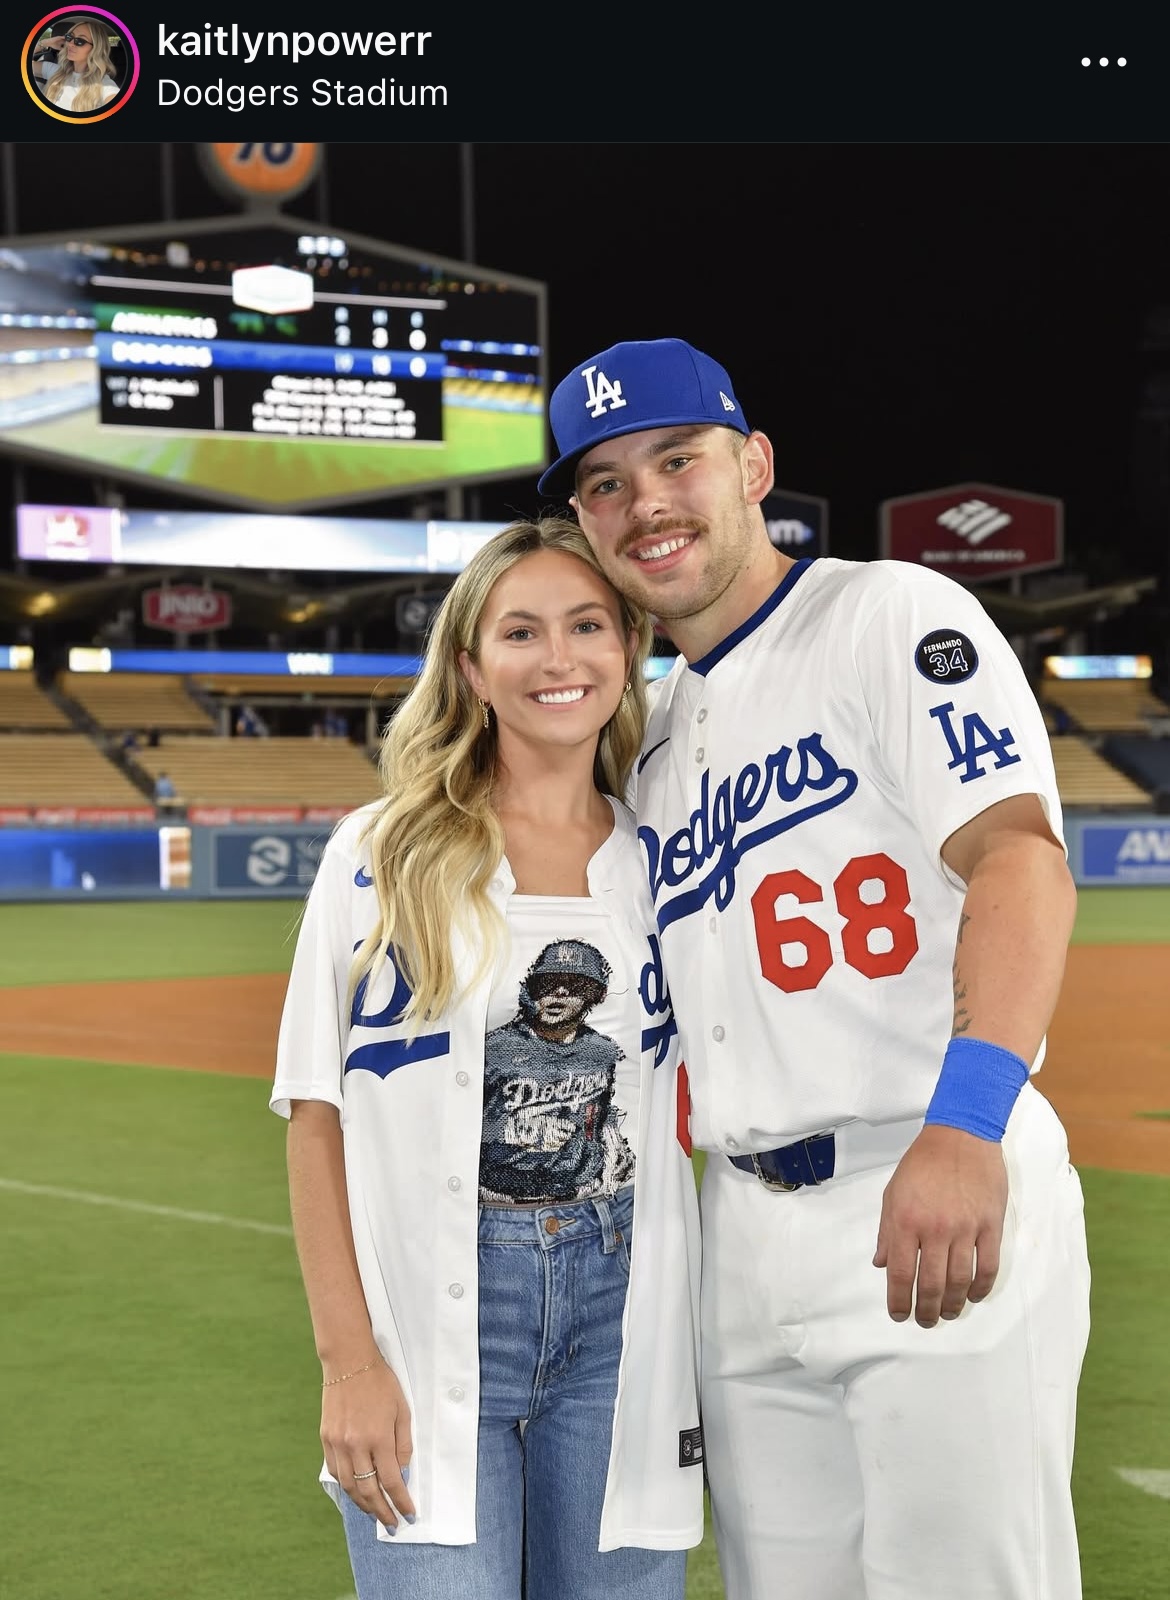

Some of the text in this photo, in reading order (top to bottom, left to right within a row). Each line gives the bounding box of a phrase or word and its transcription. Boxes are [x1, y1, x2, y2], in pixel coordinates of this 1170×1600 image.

[581, 366, 627, 418] LA
[923, 638, 963, 655] FERNANDO
[929, 648, 969, 677] 34
[929, 701, 1021, 784] LA
[751, 852, 919, 993] 68
